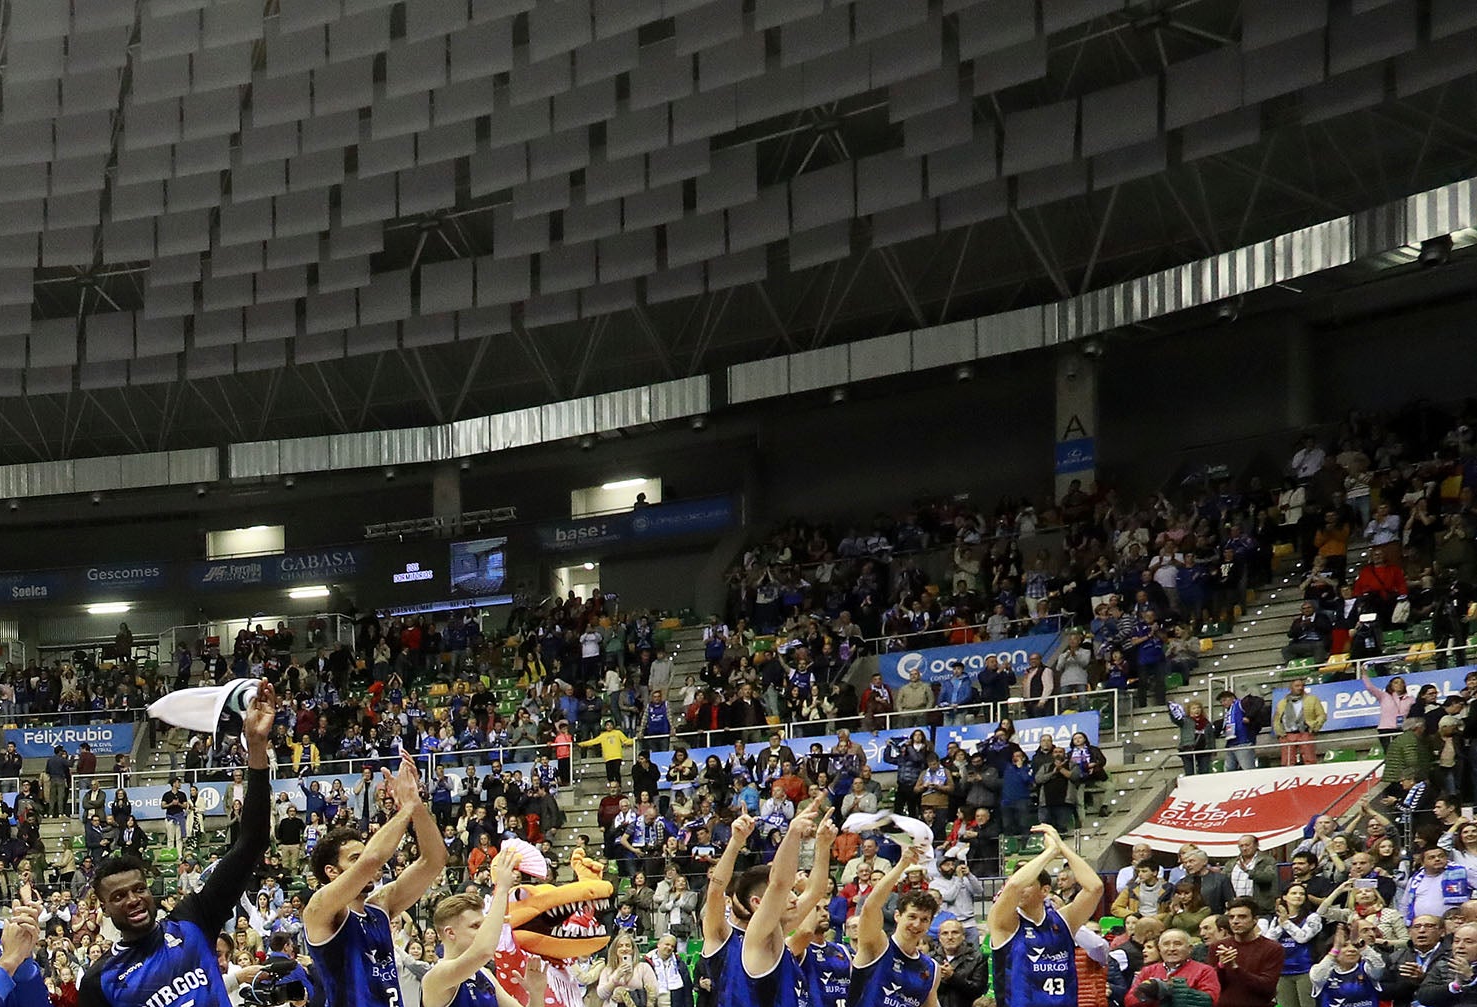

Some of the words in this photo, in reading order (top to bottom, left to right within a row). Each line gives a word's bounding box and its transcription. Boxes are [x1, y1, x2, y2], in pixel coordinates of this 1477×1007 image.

[1064, 414, 1086, 439] A
[280, 551, 357, 572] GABASA
[86, 567, 160, 581] Gescomes
[1230, 784, 1271, 800] BK
[1160, 807, 1256, 822] GLOBAL
[1042, 977, 1065, 996] 43
